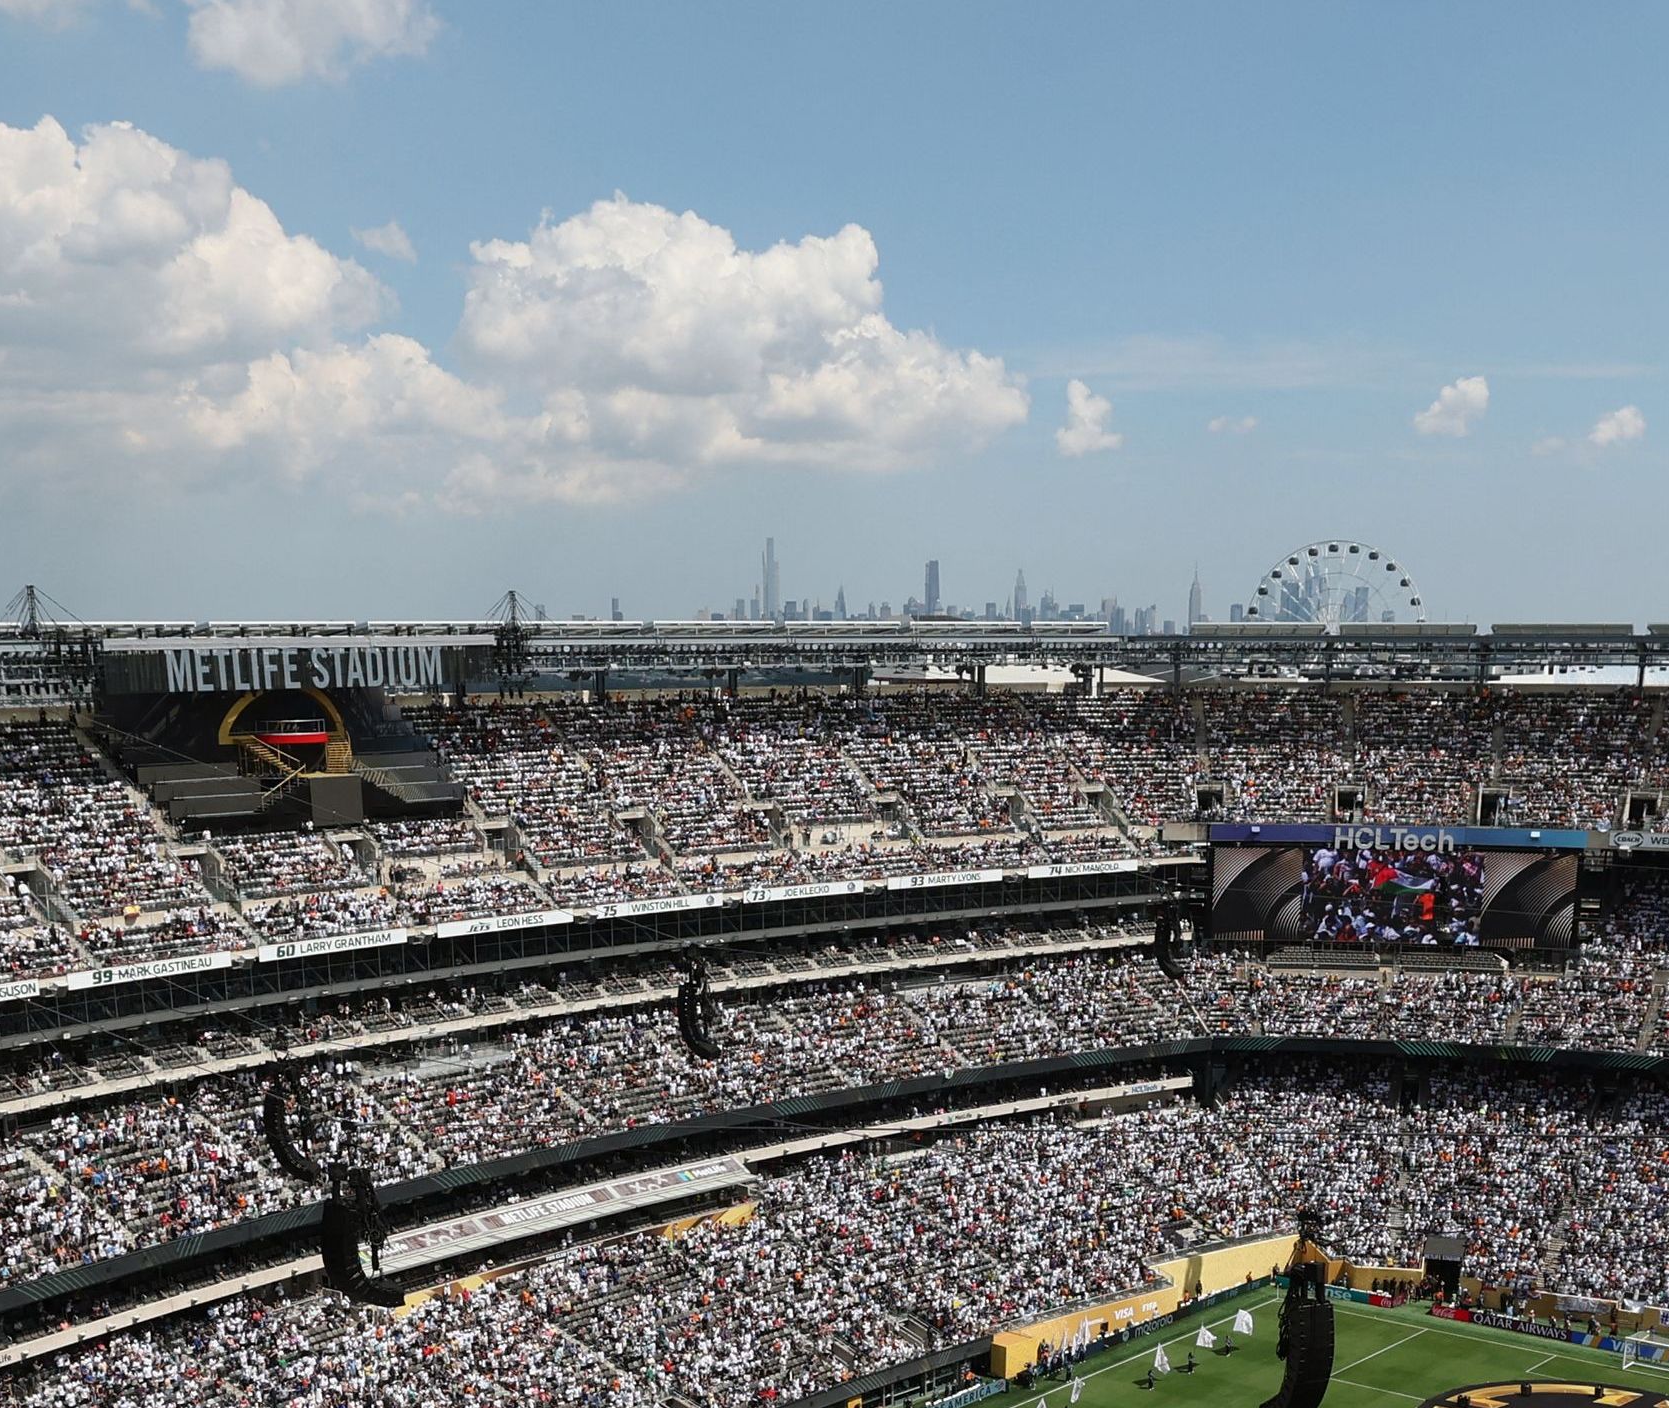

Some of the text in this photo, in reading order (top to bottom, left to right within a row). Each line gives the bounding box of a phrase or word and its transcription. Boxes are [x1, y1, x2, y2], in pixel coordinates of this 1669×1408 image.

[165, 646, 443, 692] METLIFE STADIUM
[1334, 827, 1454, 852] HCLTech
[1048, 862, 1120, 876] 74 NICK MANGOLD
[910, 871, 982, 887] 93 MARTY LYONS
[750, 884, 830, 901] 73 JOE KLECKO
[601, 898, 691, 917] 75 WINSTON HILL
[496, 916, 521, 929] LEON
[521, 914, 545, 927] HESS
[276, 932, 392, 959] 60 LARRY GRANTHAM
[92, 956, 213, 985] 99 MARK GASTINEAU
[693, 1163, 728, 1180] MetLife
[501, 1193, 596, 1226] METLIFE STADIUM
[1112, 1307, 1134, 1321] VISA
[1141, 1301, 1158, 1312] FIFA
[1134, 1314, 1173, 1339] motorola
[1473, 1313, 1569, 1341] QATAR AIRWAYS
